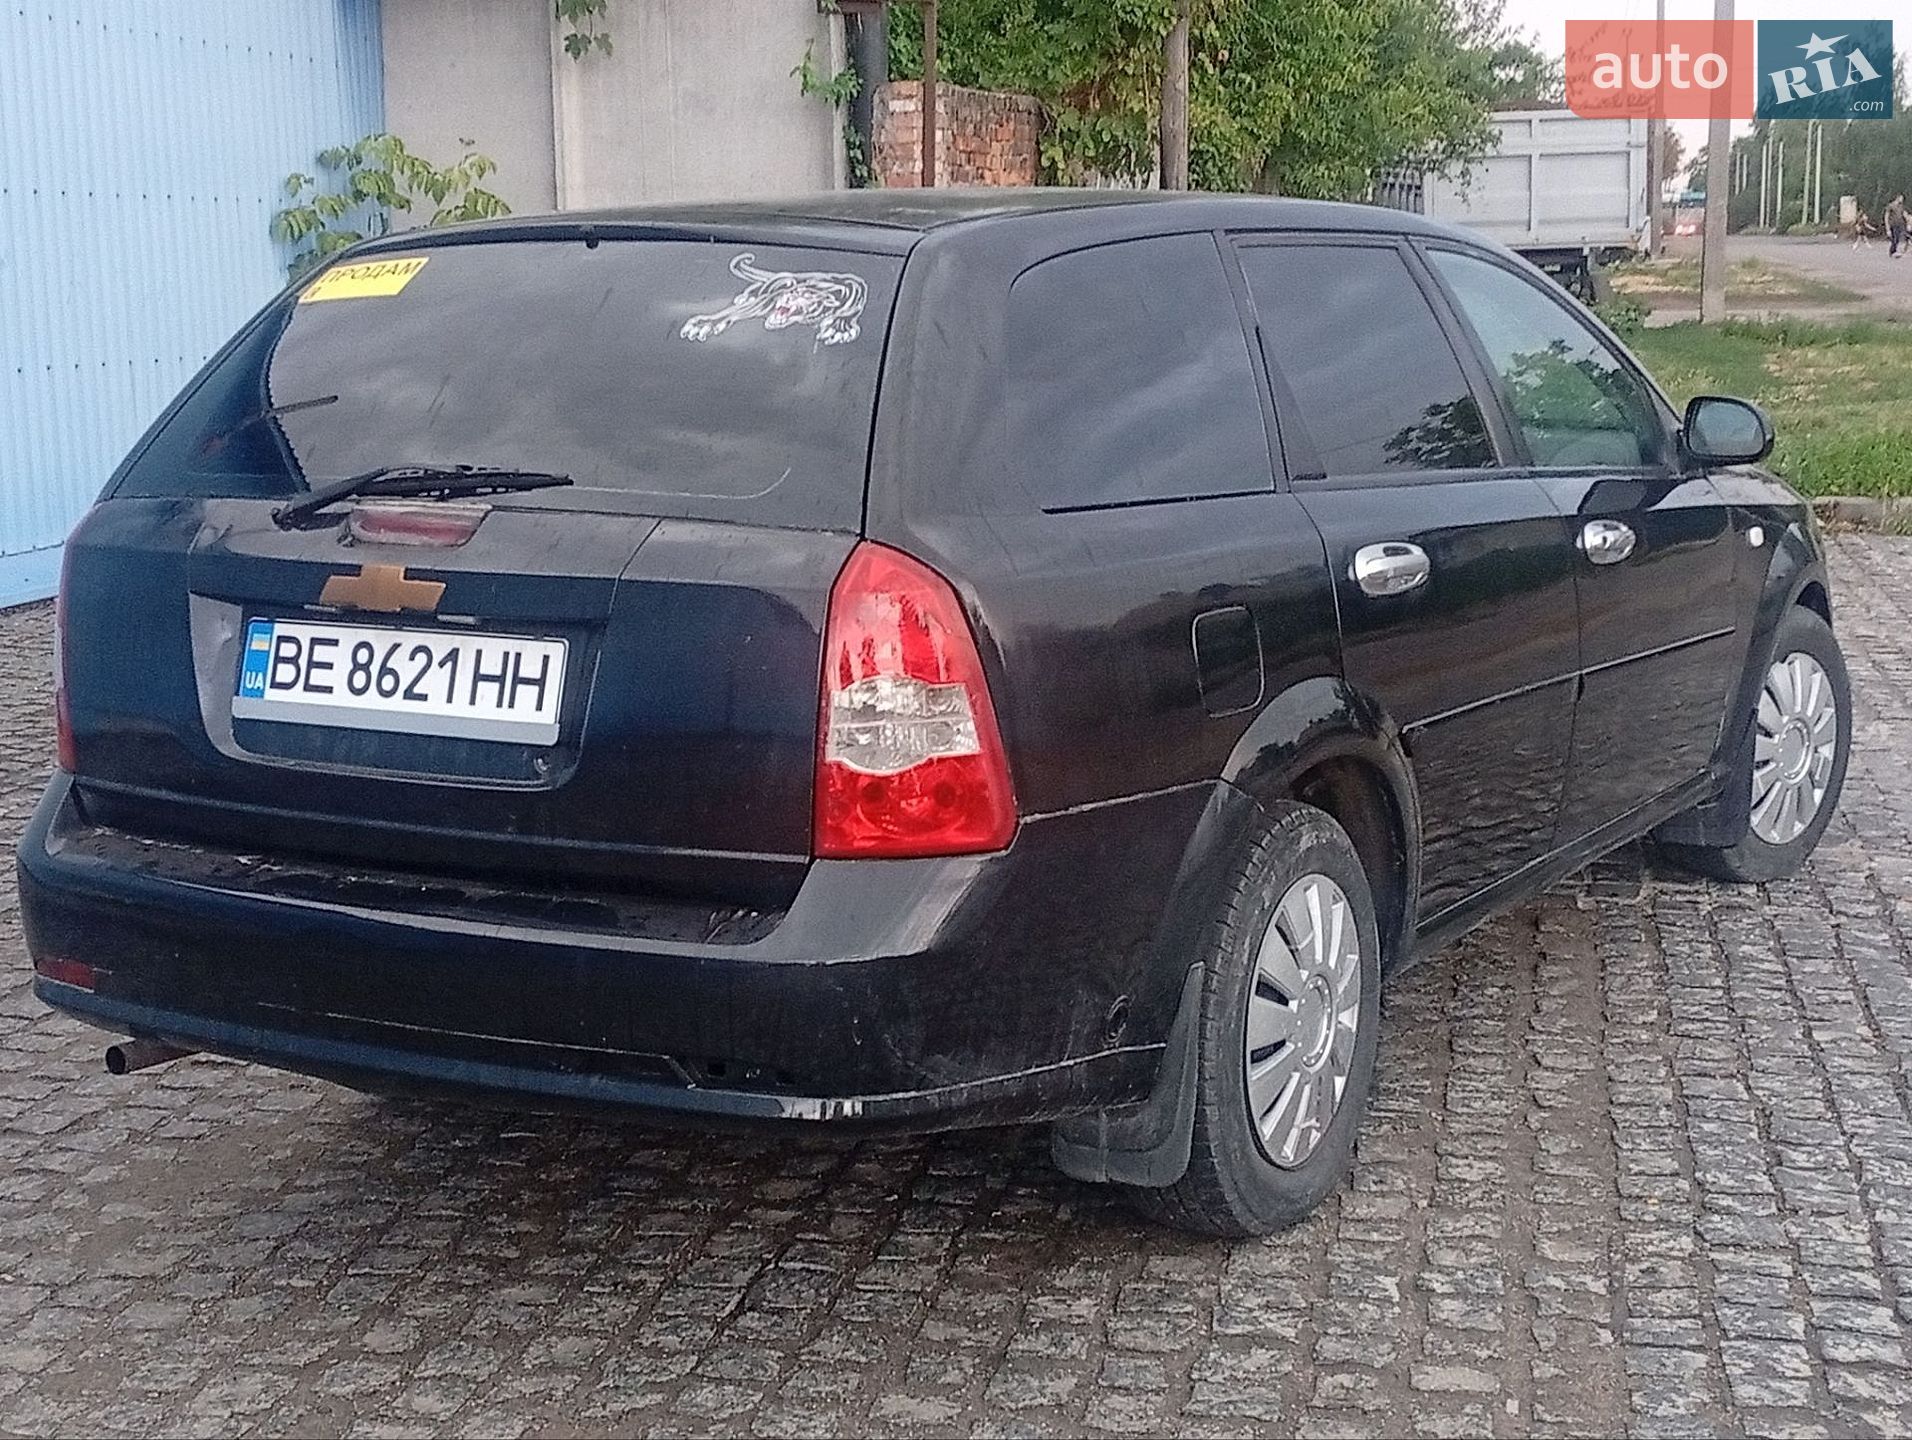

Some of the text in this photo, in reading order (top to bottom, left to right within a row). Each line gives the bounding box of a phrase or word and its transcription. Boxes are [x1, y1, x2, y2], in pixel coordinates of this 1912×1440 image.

[320, 260, 422, 284] ПРОДАМ
[245, 671, 264, 690] UA
[269, 634, 551, 712] BE 8621 HH
